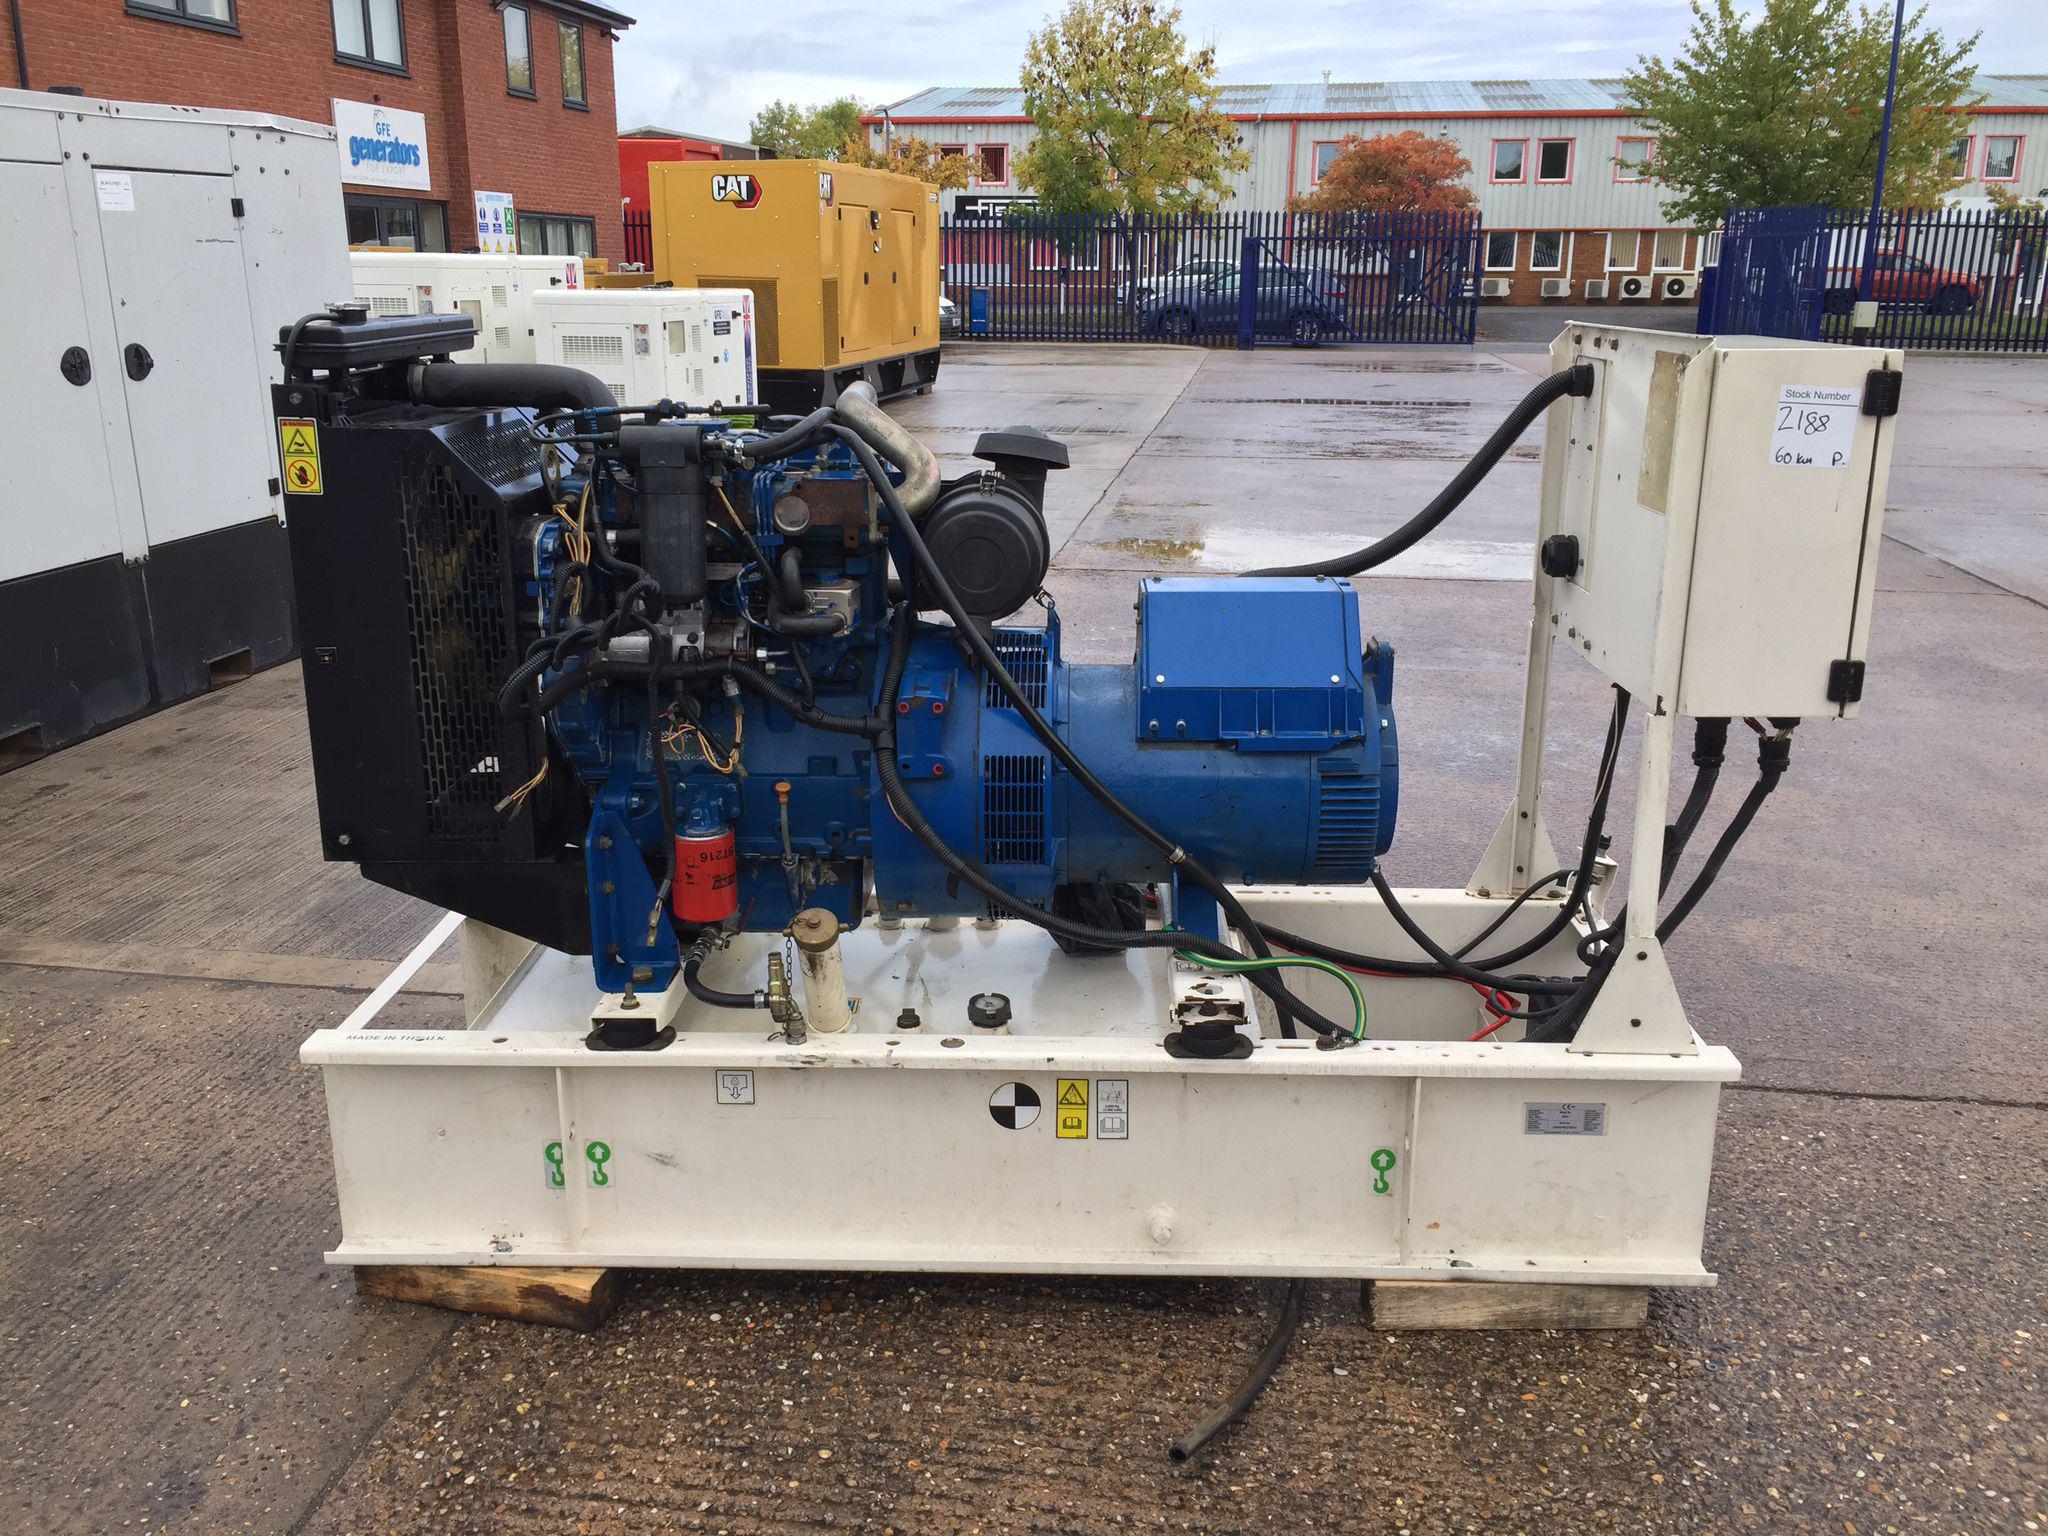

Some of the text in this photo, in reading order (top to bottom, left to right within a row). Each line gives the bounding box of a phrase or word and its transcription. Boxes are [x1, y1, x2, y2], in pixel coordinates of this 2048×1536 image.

[375, 121, 391, 137] GFE
[349, 135, 420, 167] generators
[712, 175, 750, 201] CAT
[819, 172, 831, 200] CAT
[1785, 389, 1852, 401] Stock Number
[1777, 405, 1830, 436] 2188
[1775, 446, 1793, 465] 60
